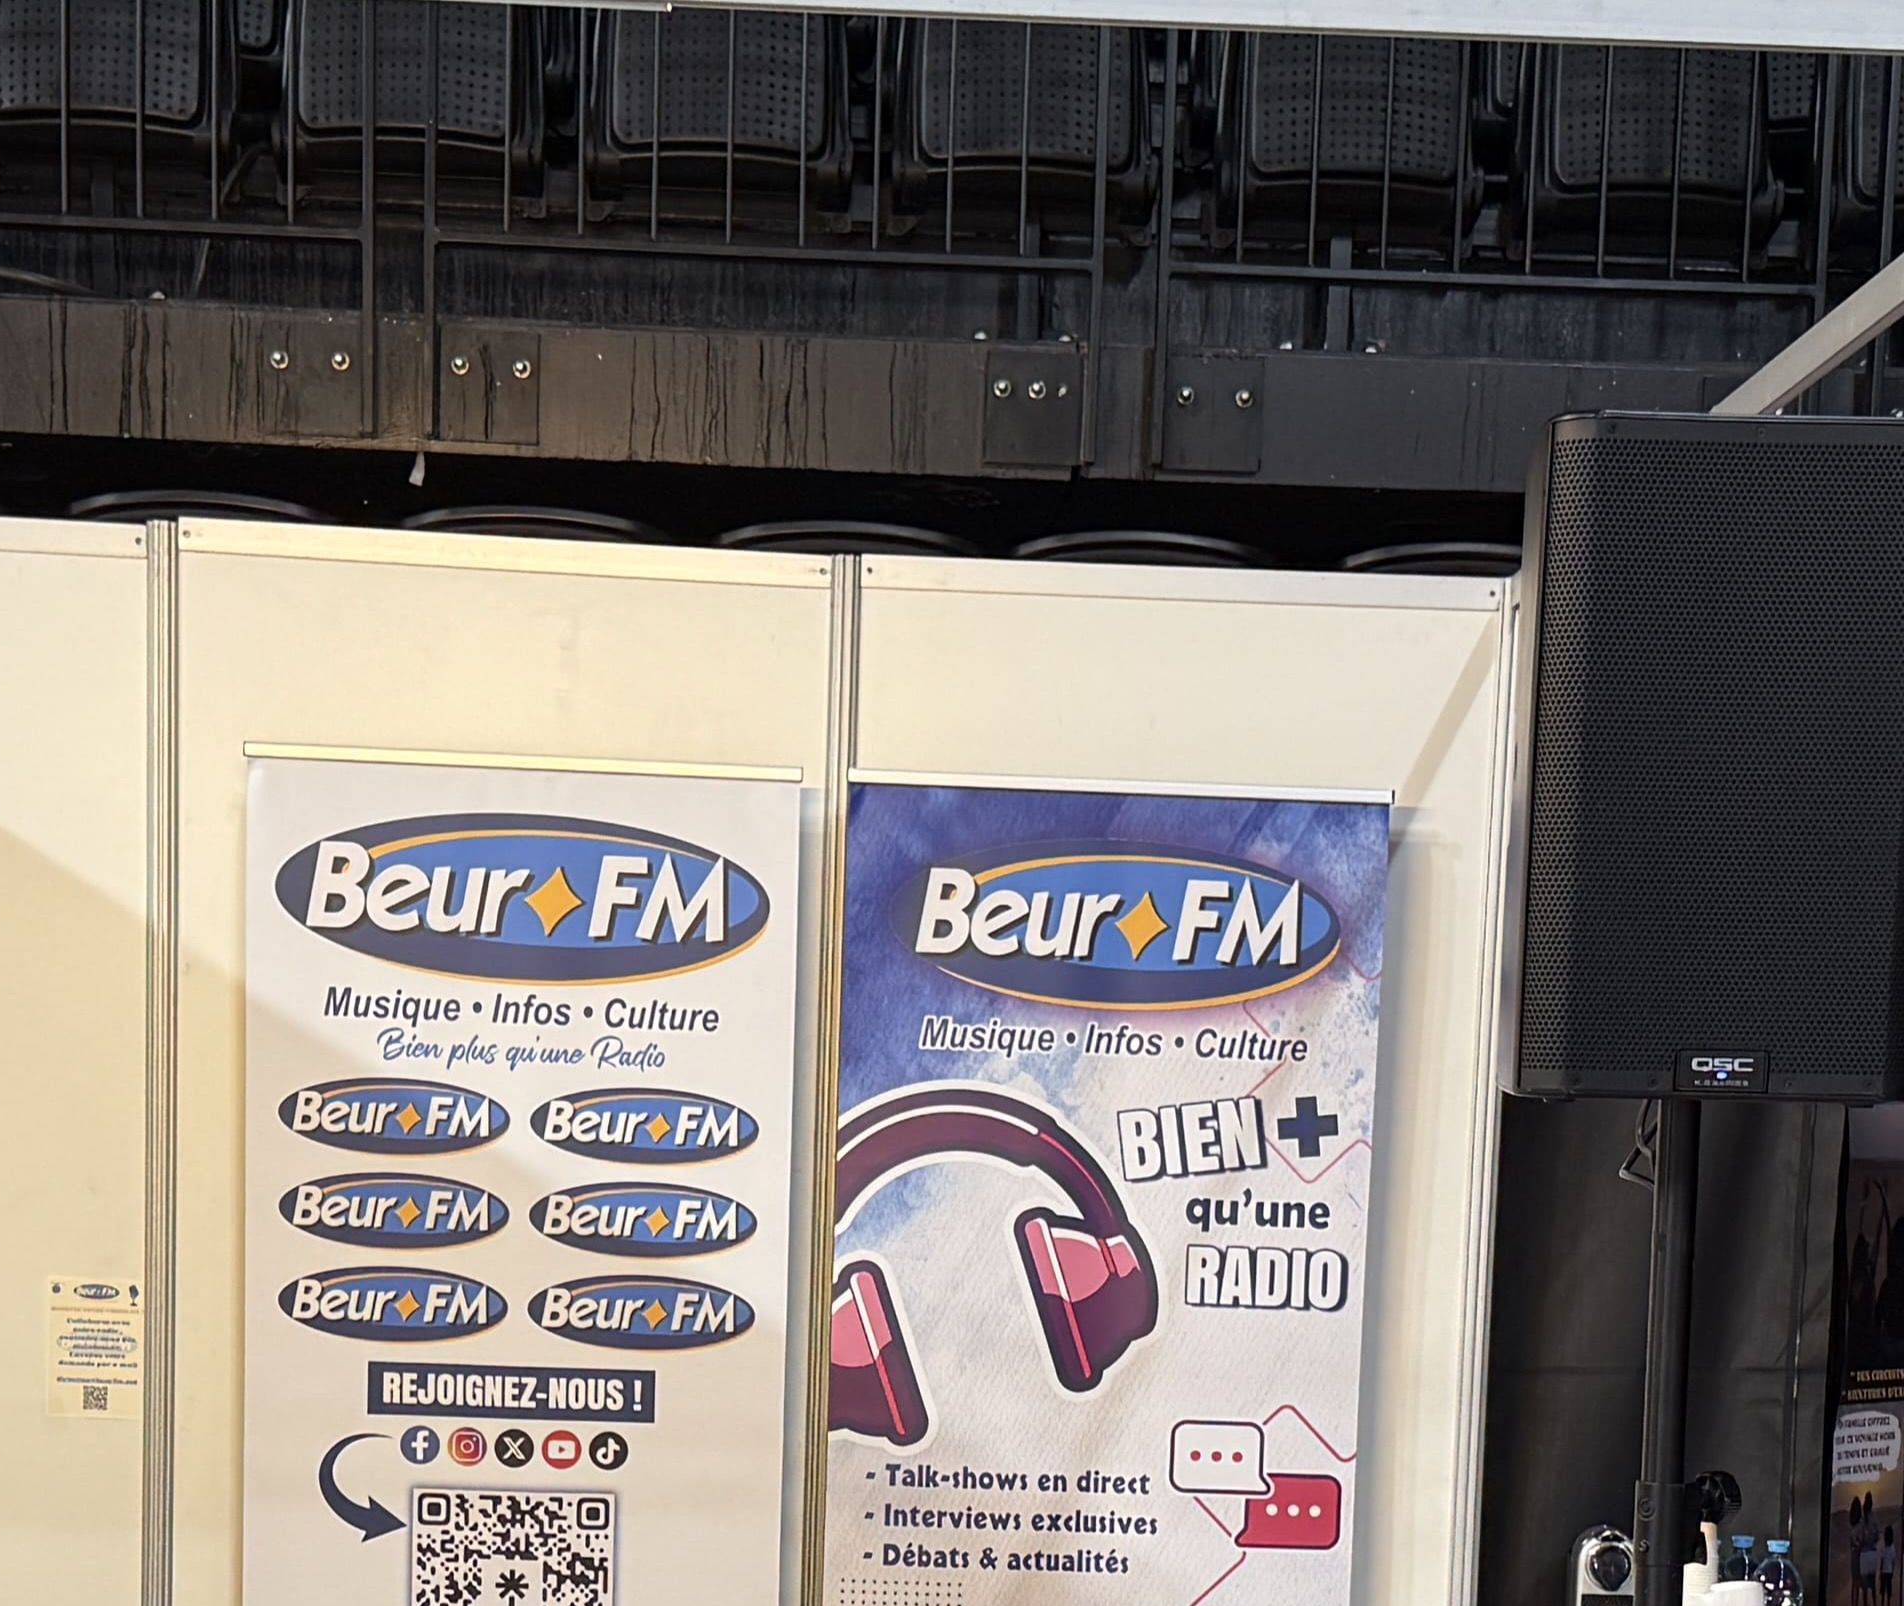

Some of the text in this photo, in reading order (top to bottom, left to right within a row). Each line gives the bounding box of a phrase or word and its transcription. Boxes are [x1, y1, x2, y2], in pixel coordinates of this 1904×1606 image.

[306, 841, 729, 945] Beur FM
[915, 867, 1302, 968] Beur FM
[324, 986, 720, 1032] Musique Infos Culture
[377, 1028, 443, 1061] Bien
[446, 1035, 498, 1069] plus
[591, 1036, 666, 1069] Radio
[919, 1016, 1309, 1062] Musique Infos Culture
[1691, 1057, 1754, 1072] QSC
[292, 1090, 490, 1138] Beur FM
[543, 1100, 740, 1147] Beur FM
[1117, 1097, 1268, 1183] BIEN
[292, 1185, 489, 1232] Beur FM
[543, 1194, 738, 1241] Beur FM
[1185, 1243, 1349, 1311] RADIO
[291, 1279, 489, 1325] Beur FM
[541, 1288, 736, 1334] Beur FM
[383, 1371, 625, 1411] REJOIGNEZ-NOUS
[886, 1464, 1151, 1496] Talk-shows en direct
[883, 1504, 1158, 1536] Interviews exclusives
[882, 1543, 1129, 1574] Débats & actualités
